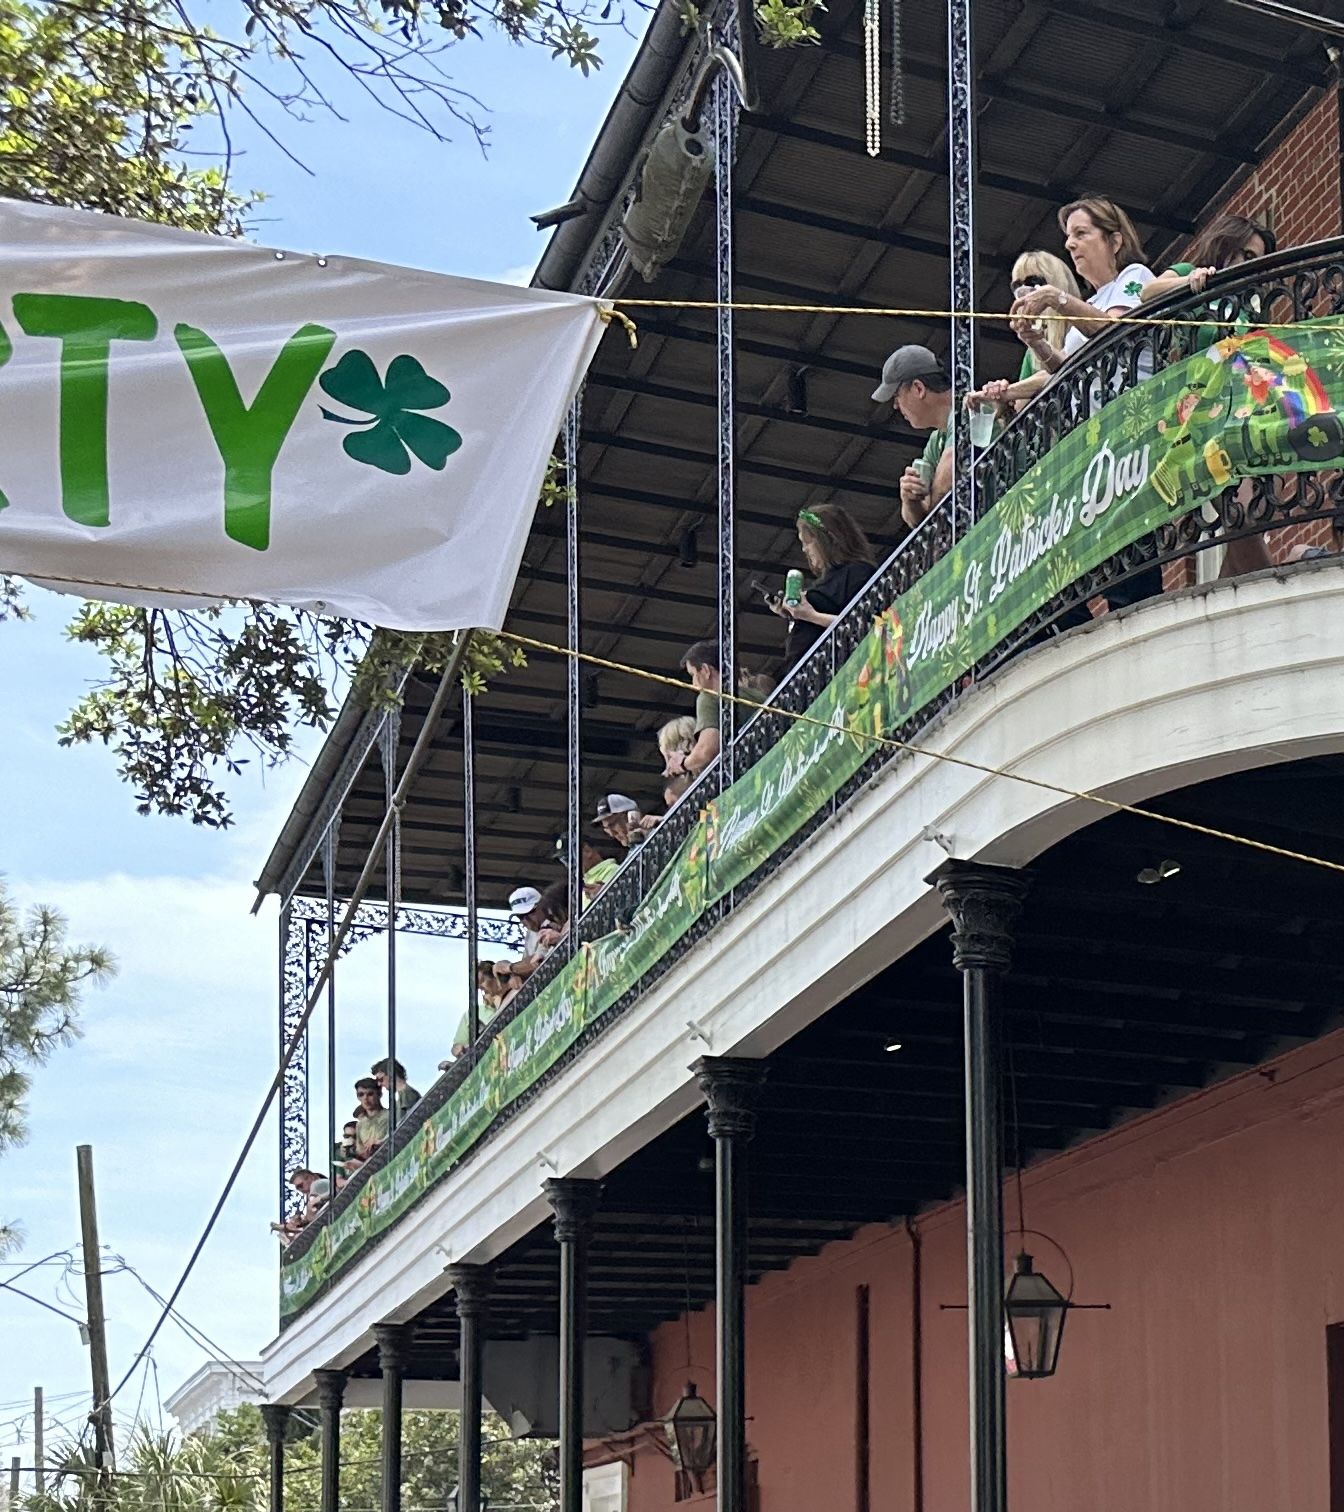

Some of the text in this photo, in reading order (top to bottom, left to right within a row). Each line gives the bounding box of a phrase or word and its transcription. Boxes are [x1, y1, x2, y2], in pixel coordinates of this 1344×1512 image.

[906, 438, 1151, 671] Happy St. Patrick's Day
